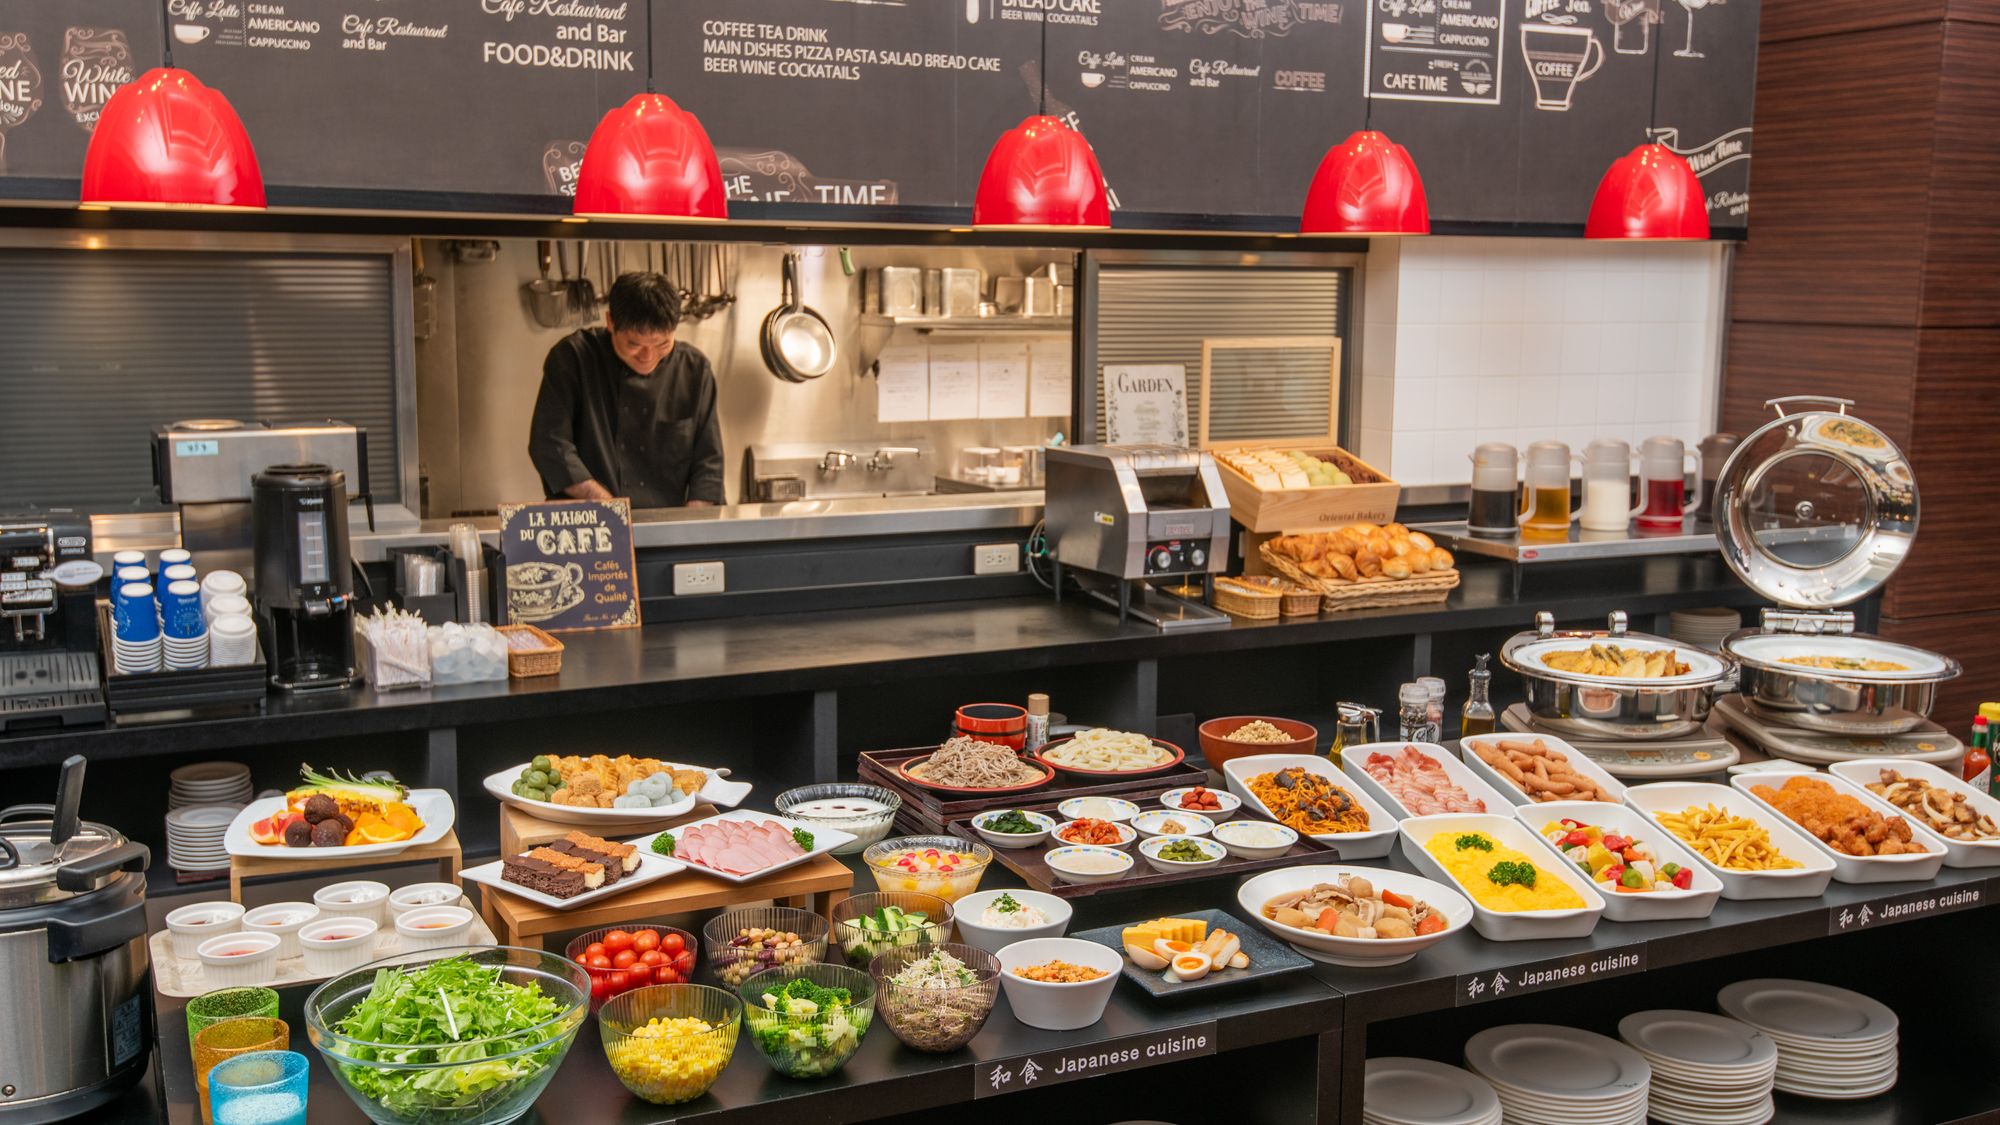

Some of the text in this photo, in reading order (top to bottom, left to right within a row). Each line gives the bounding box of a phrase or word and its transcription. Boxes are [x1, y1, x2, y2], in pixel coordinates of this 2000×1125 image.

[248, 4, 284, 15] CREAM
[528, 0, 628, 20] Restaurant
[1001, 10, 1098, 25] BEER WIN COCKATAILS
[248, 18, 320, 33] AMERICANO
[341, 14, 448, 39] Cafe Restaurant
[1440, 13, 1499, 29] AMERICANO
[556, 23, 627, 43] and Bar
[702, 20, 828, 43] COFFEE TEA DRINK
[1440, 33, 1490, 47] CAPPUCCINO
[248, 37, 311, 51] CAPPUCCINO
[342, 38, 387, 51] and Bar
[483, 42, 634, 71] FOOD&DRINK
[703, 39, 1001, 72] MAIN DISHES PIZZA PASTA SALAD BREAD CAKE
[1130, 54, 1155, 64] CREAM
[0, 60, 21, 80] ed
[63, 59, 132, 83] White
[703, 57, 861, 81] BEER WINE COCKATAILS
[1129, 66, 1178, 78] AMERICANO
[1535, 61, 1574, 77] COFFEE
[1129, 81, 1171, 92] CAPPUCCINO
[1189, 77, 1221, 88] and Bar
[1274, 70, 1326, 89] COFFEE
[1383, 72, 1448, 91] CAFE TIME
[64, 80, 116, 104] WIN
[724, 175, 753, 198] HE
[1117, 372, 1174, 394] GARDEN
[529, 510, 598, 527] LA MAISON
[1319, 509, 1386, 523] Oriental Bakery
[520, 521, 613, 556] DU CAFÉ
[604, 583, 616, 592] de
[1880, 898, 1936, 919] Japanese
[1939, 890, 1980, 908] cuisine
[1518, 963, 1586, 987] Japanese
[1590, 953, 1639, 973] cuisine
[1055, 1048, 1140, 1075] Japanese
[1146, 1034, 1207, 1057] cuisine
